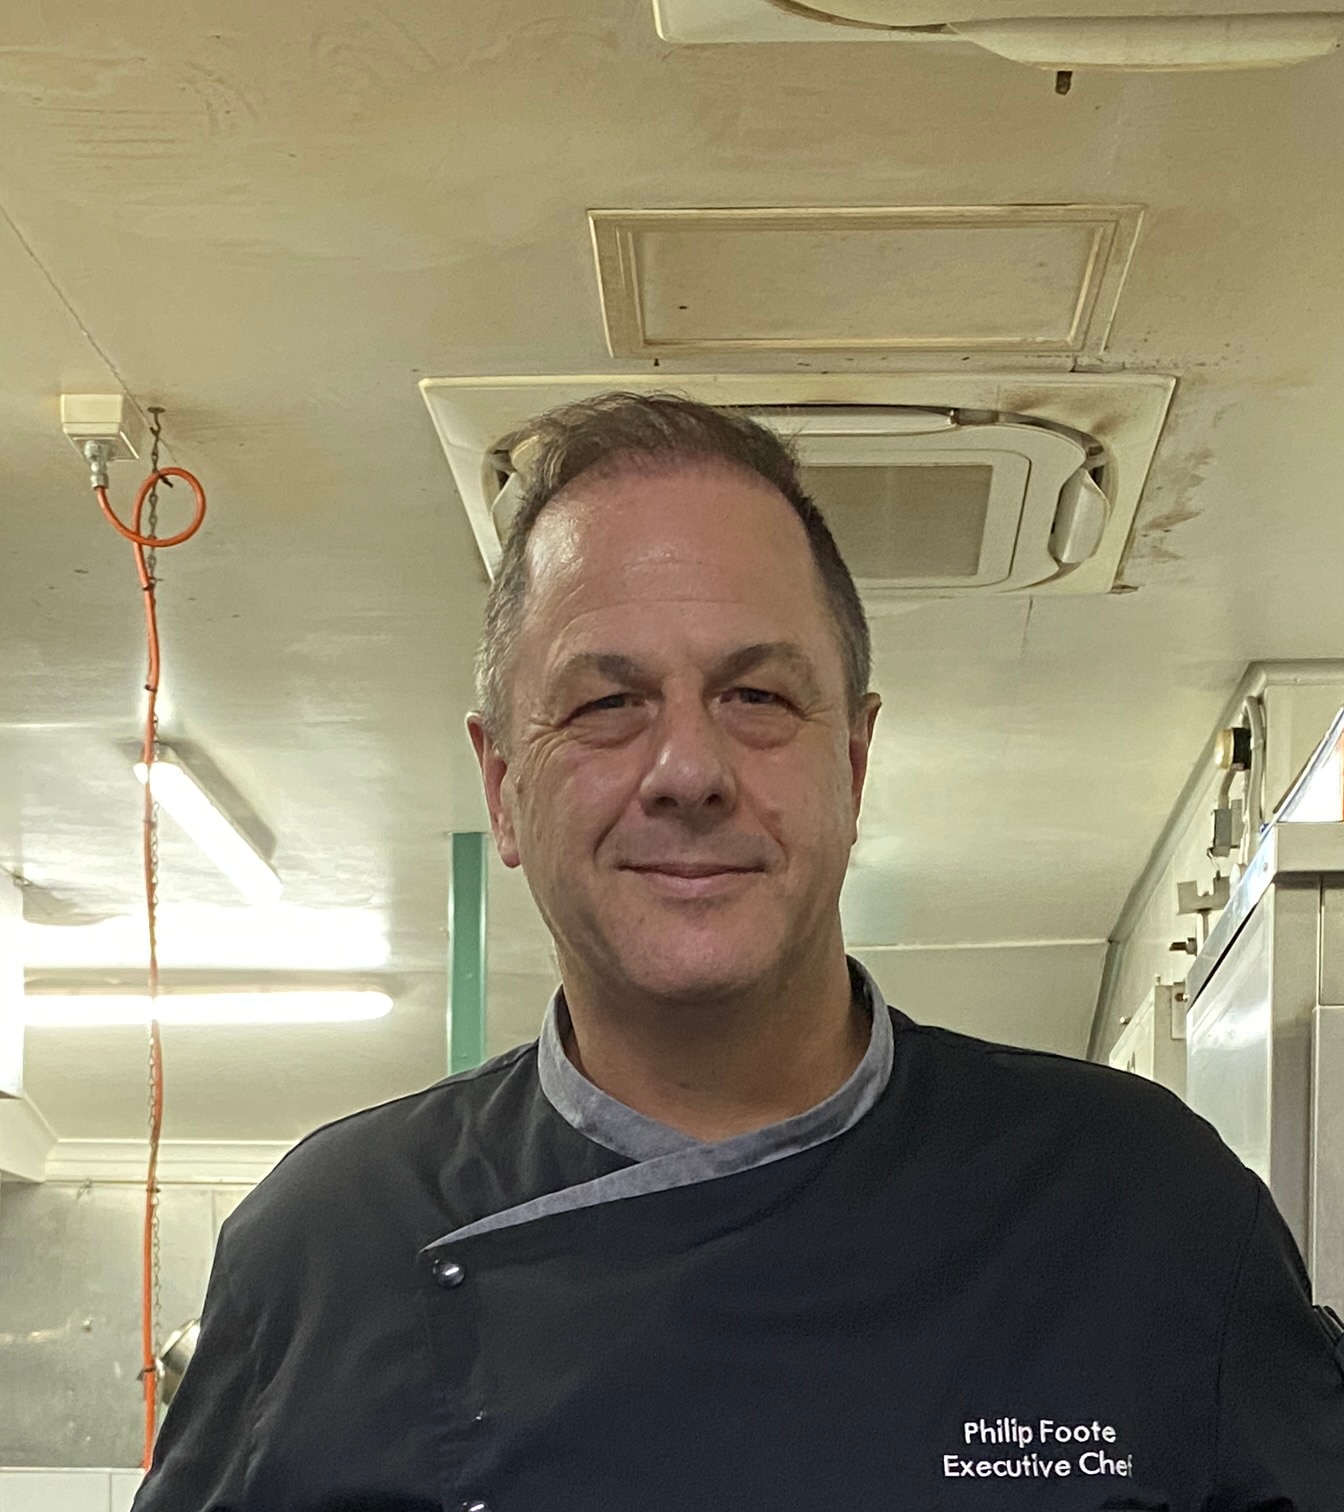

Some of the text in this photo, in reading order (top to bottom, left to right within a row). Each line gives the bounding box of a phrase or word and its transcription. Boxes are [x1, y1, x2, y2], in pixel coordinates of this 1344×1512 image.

[964, 1417, 1117, 1448] Philip Foote
[942, 1453, 1071, 1478] Executive
